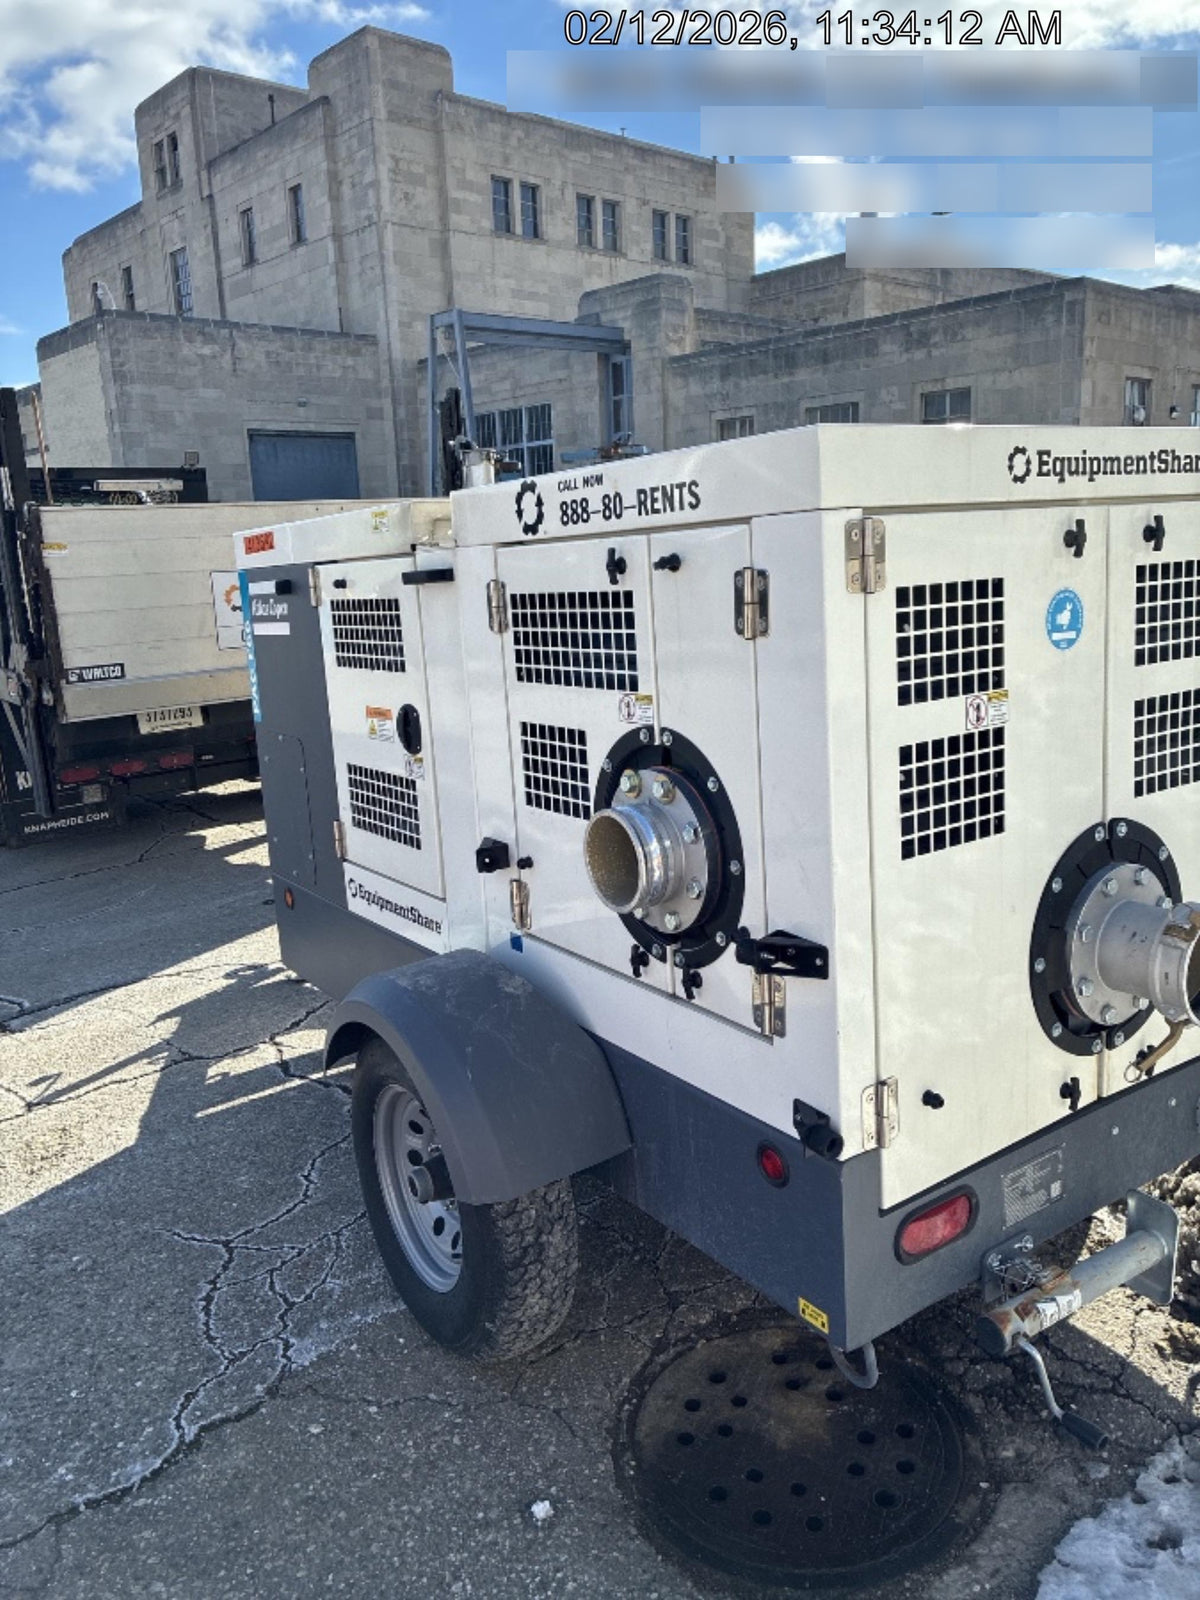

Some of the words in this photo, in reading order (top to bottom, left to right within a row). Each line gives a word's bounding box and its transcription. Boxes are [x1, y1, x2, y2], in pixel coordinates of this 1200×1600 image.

[558, 478, 579, 493] CALL
[583, 473, 603, 489] NOW
[560, 480, 700, 527] 888-80-RENTS
[82, 665, 121, 680] WALTCO
